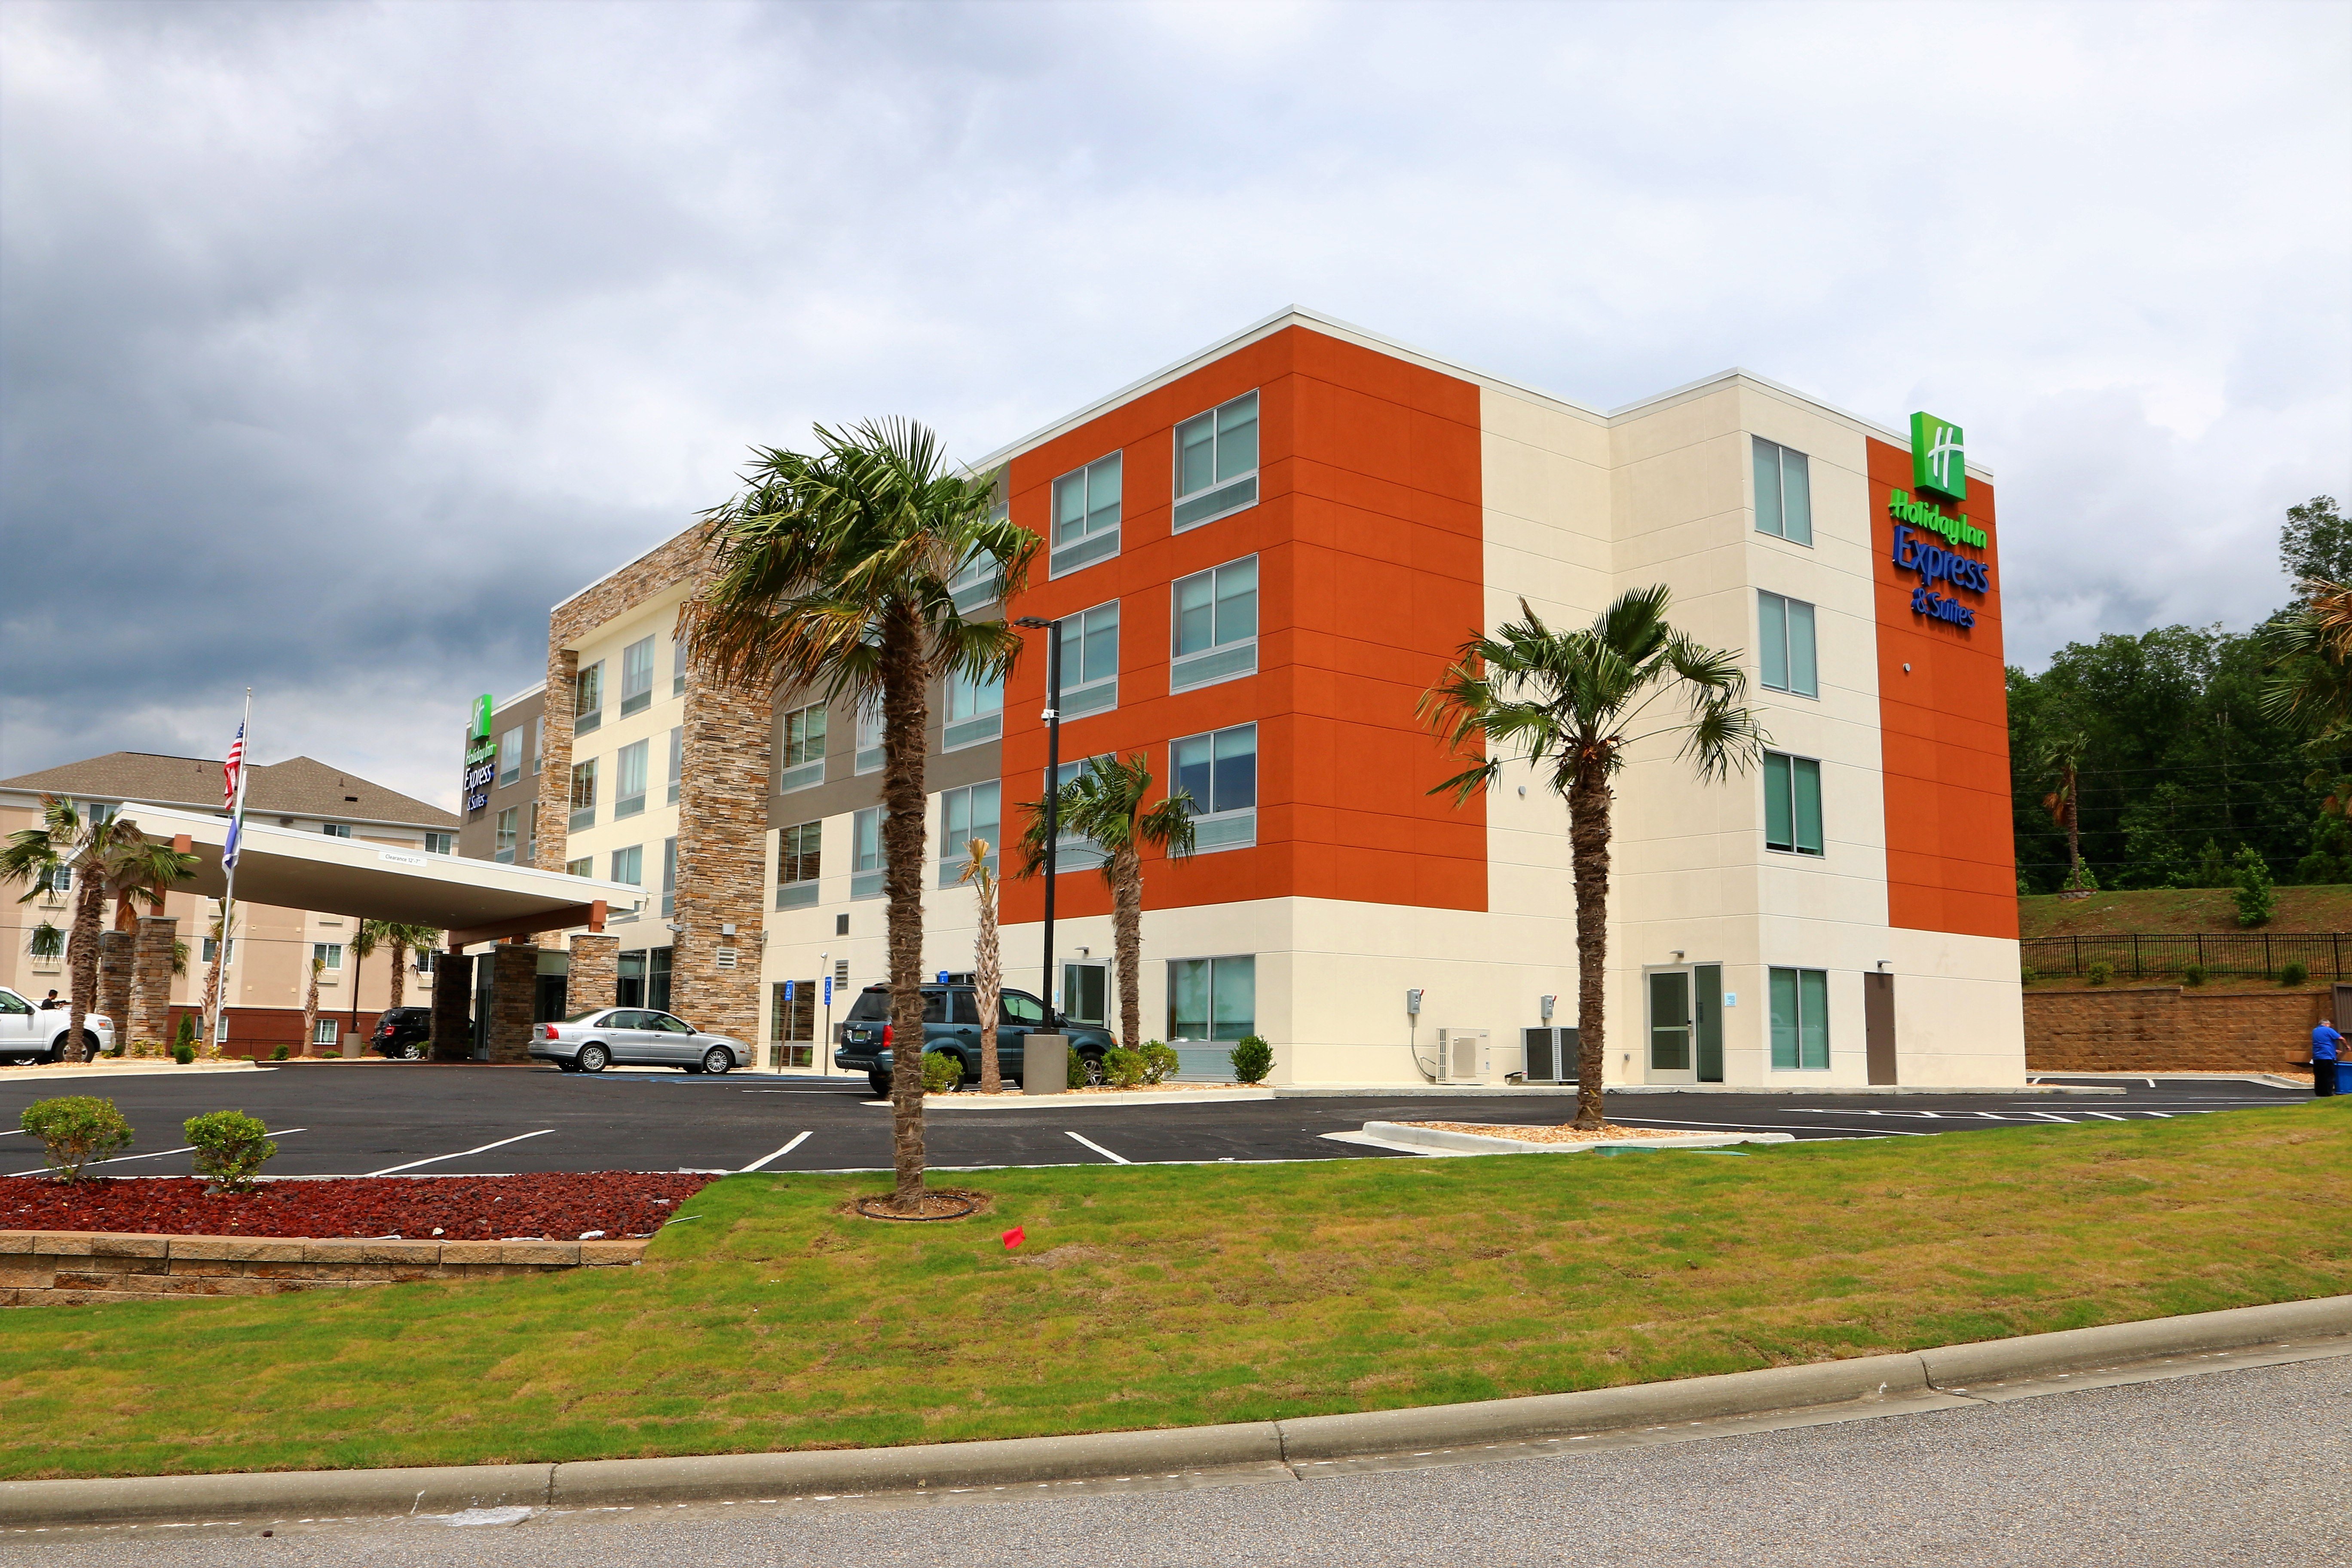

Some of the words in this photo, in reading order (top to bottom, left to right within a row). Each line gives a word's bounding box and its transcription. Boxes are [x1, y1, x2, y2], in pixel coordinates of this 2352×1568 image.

[1893, 525, 1989, 594] Express
[1911, 587, 1928, 614] &
[1926, 592, 1975, 628] Suites
[464, 763, 493, 794] Express
[467, 797, 472, 811] &
[471, 794, 486, 810] Suites
[385, 854, 407, 862] Clearance
